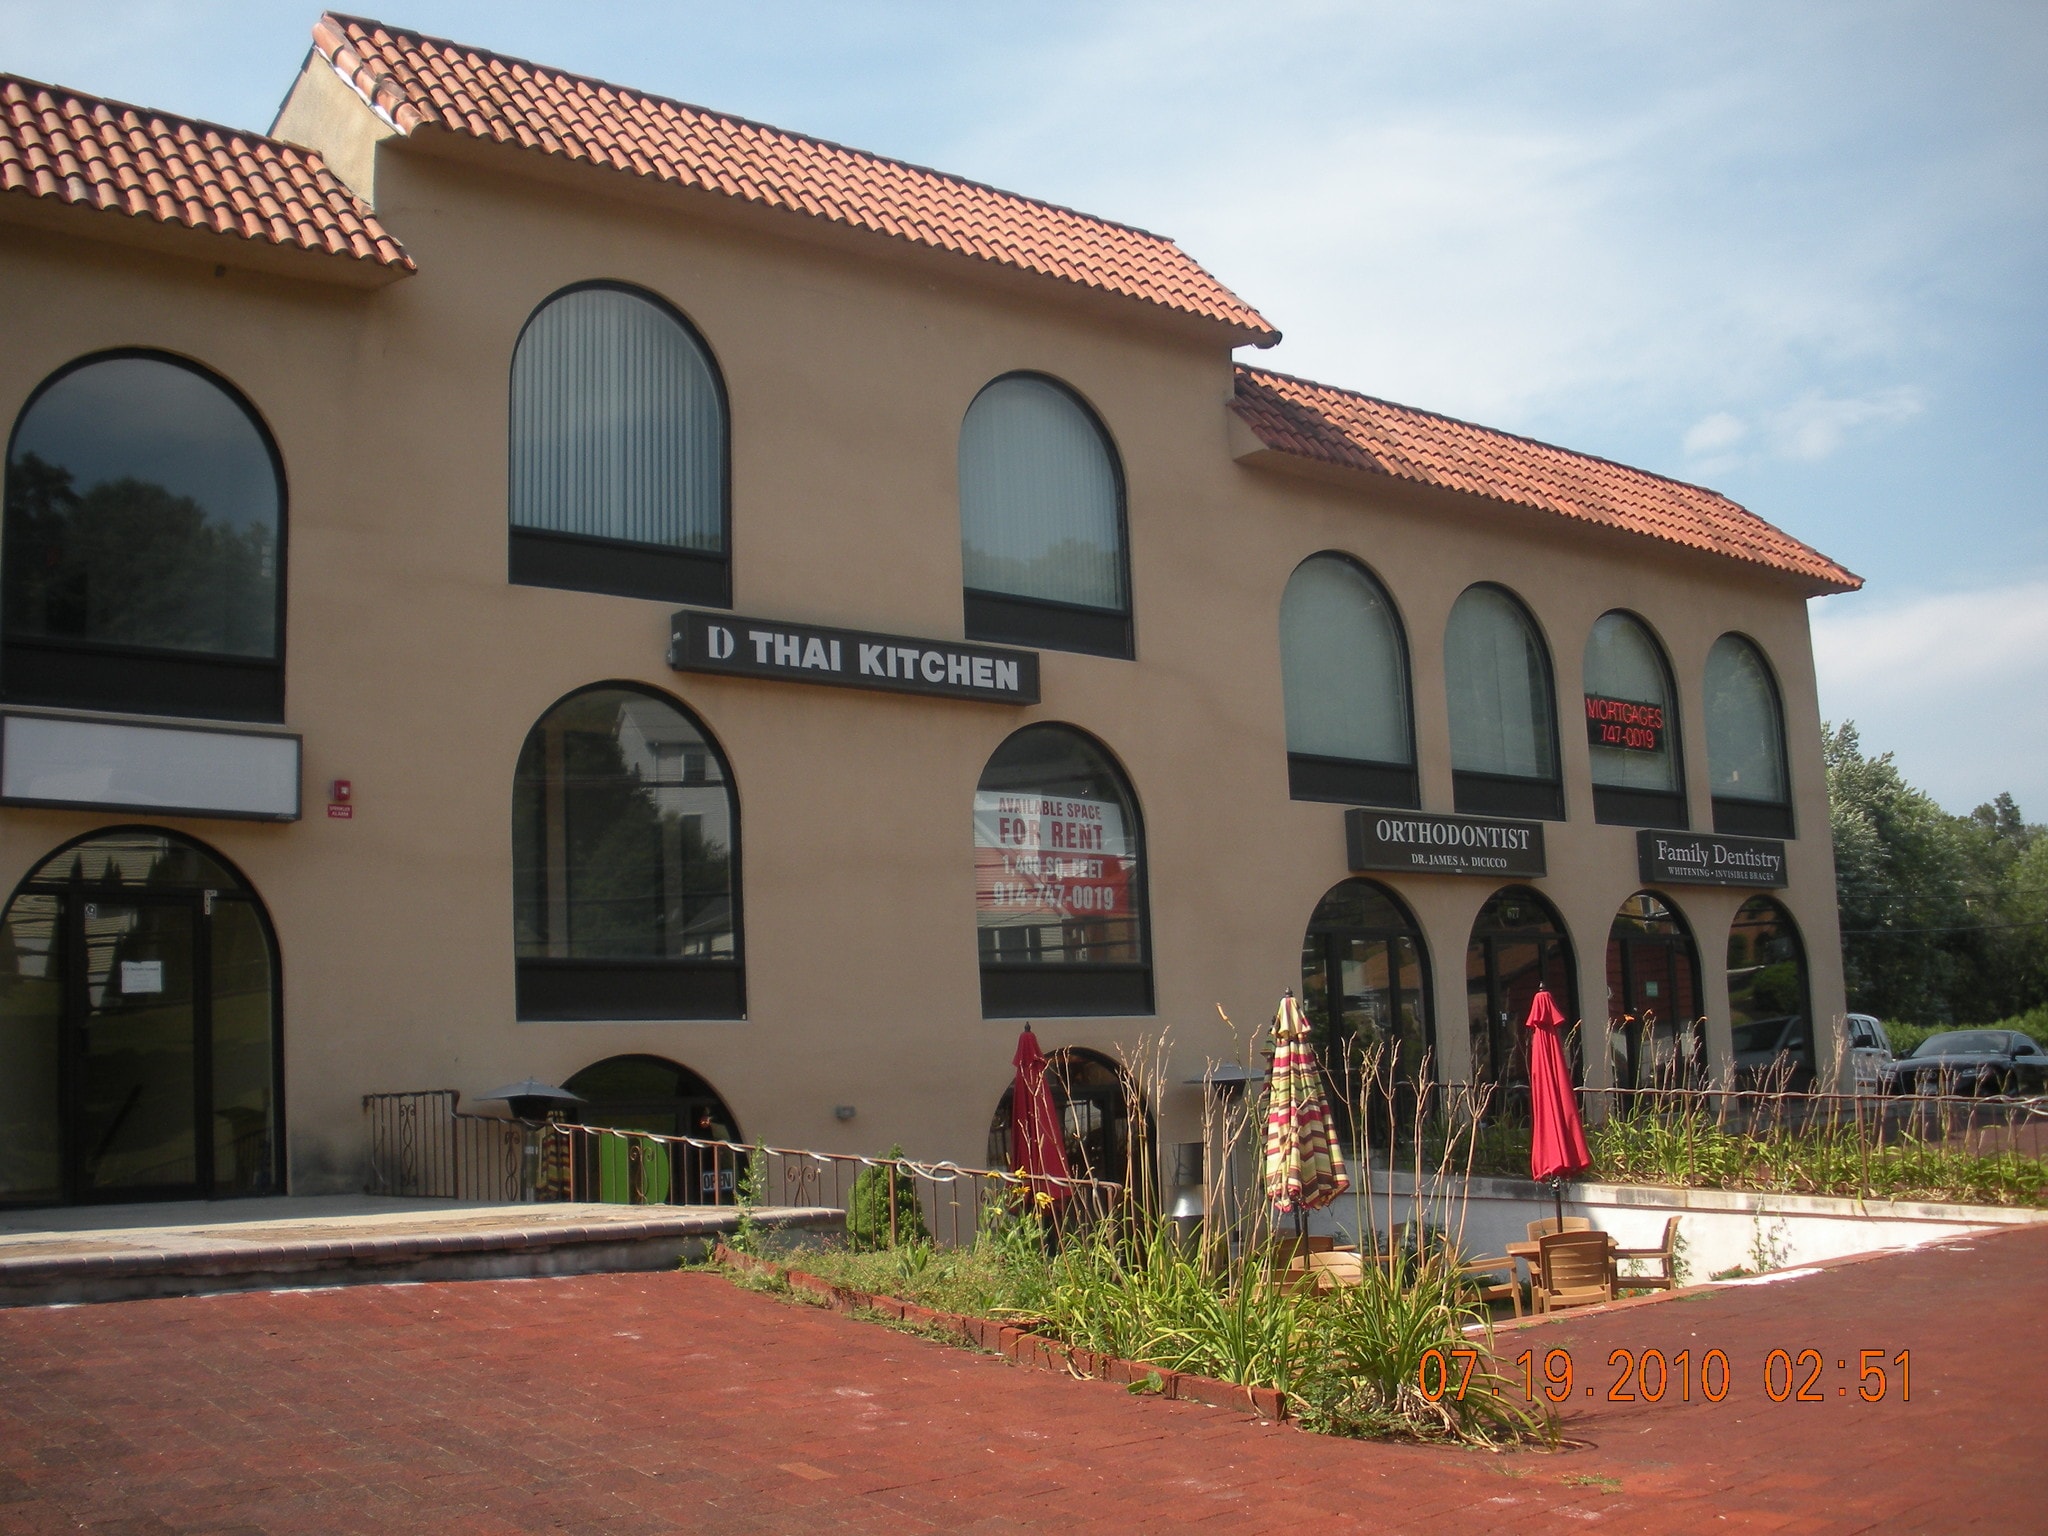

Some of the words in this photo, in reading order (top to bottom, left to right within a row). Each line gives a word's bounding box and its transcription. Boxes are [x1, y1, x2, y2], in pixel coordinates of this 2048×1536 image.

[707, 625, 735, 660] D
[749, 630, 842, 672] THAI
[858, 643, 1019, 692] KITCHEN
[1586, 697, 1664, 729] MORTGAGES
[1601, 723, 1655, 749] 747-0019
[998, 797, 1063, 817] AVAILABLE
[1067, 802, 1102, 821] SPACE
[999, 817, 1041, 847] FOR
[1052, 820, 1103, 851] RENT
[1376, 819, 1530, 850] ORTHODONTIST
[1411, 853, 1428, 865] DR.
[1429, 854, 1459, 867] JAMES
[1459, 857, 1469, 867] A.
[1471, 856, 1508, 869] DICICCO
[1655, 839, 1709, 867] Family
[1712, 844, 1781, 872] Dentistry
[1668, 866, 1710, 877] WHITENING
[1715, 869, 1749, 880] INVISIBLE
[1749, 871, 1775, 881] BRACES
[993, 881, 1114, 910] 914-747-0019
